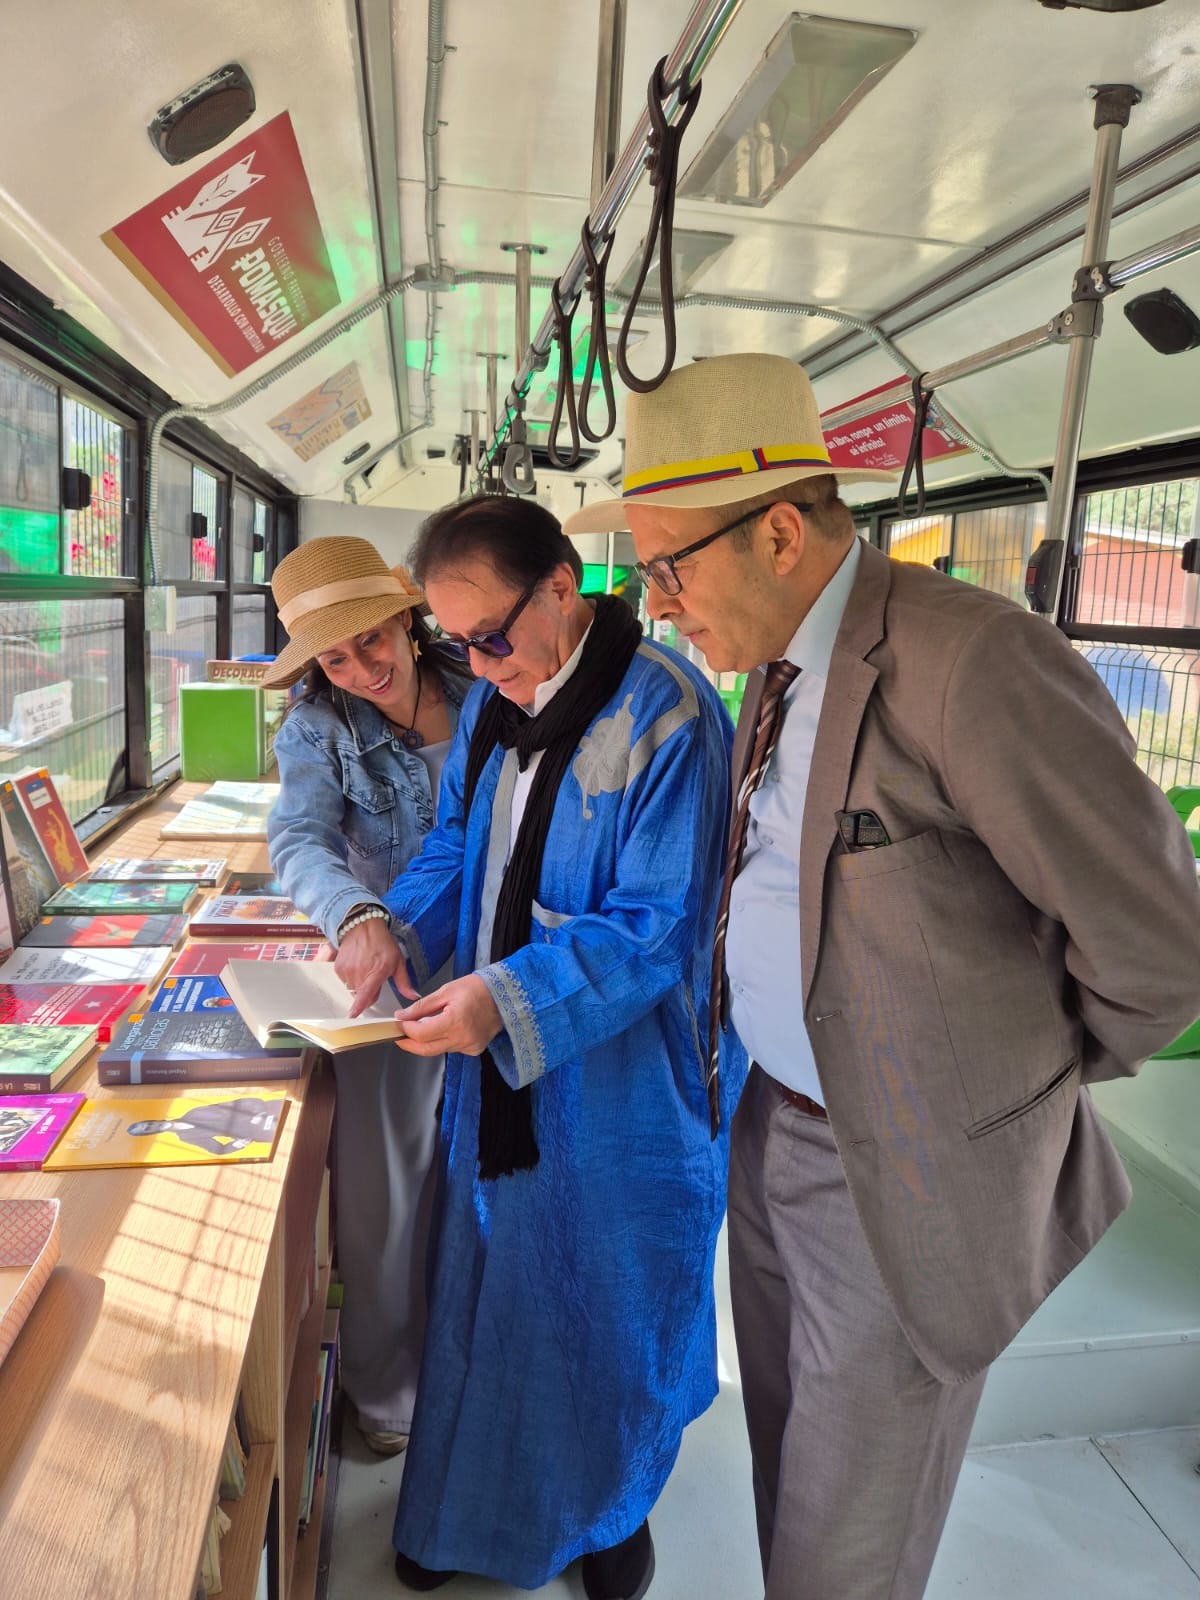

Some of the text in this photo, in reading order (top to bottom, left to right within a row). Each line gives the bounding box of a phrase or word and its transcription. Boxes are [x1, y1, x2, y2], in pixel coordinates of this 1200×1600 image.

[268, 236, 294, 280] GOBIERNO
[207, 274, 265, 353] DESARROLLO CON IDENTIDAD
[230, 247, 297, 340] POMASQUI
[850, 426, 874, 441] rompe
[874, 422, 886, 432] un
[123, 1019, 145, 1045] venganz
